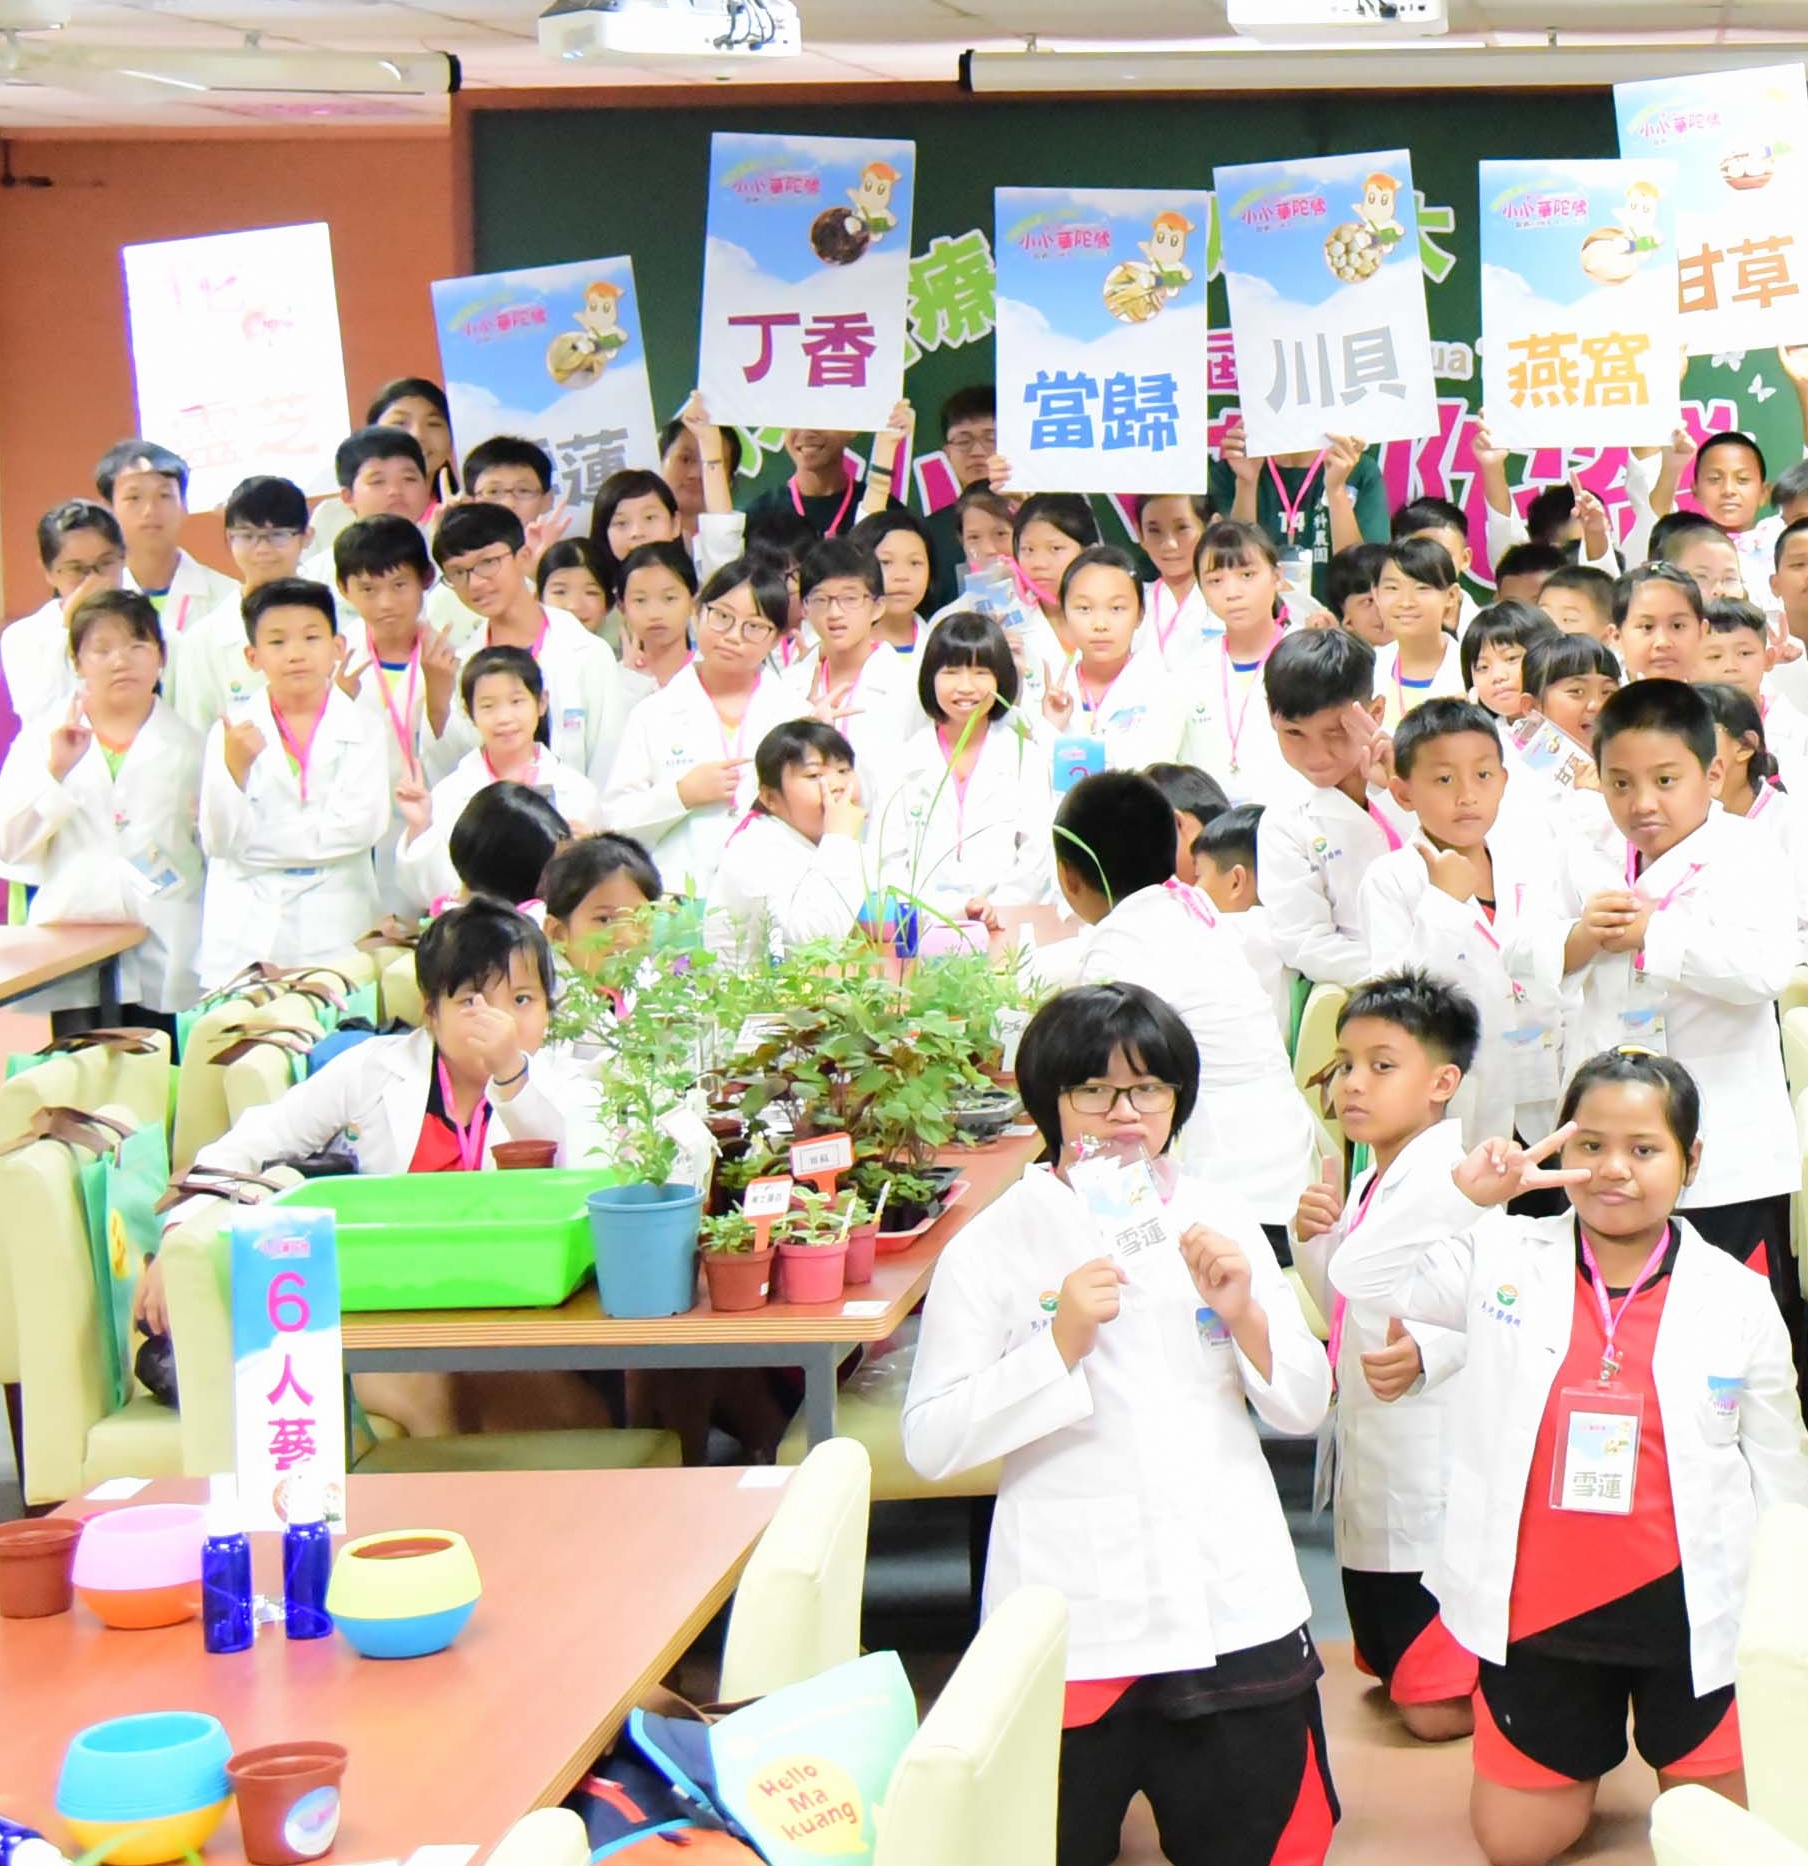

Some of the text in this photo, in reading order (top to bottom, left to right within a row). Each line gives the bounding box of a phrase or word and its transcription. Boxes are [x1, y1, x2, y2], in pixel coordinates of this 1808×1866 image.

[1678, 235, 1799, 314] 甘草
[728, 312, 877, 388] 丁香
[1264, 325, 1407, 415] 川貝
[1507, 331, 1650, 409] 燕窩
[1023, 370, 1180, 452] 當歸
[1114, 1217, 1167, 1257] 雪蓮
[266, 1271, 311, 1333] 6
[1572, 1470, 1622, 1500] 雪蓮
[758, 1764, 818, 1797] Hello
[787, 1788, 829, 1814] Ma
